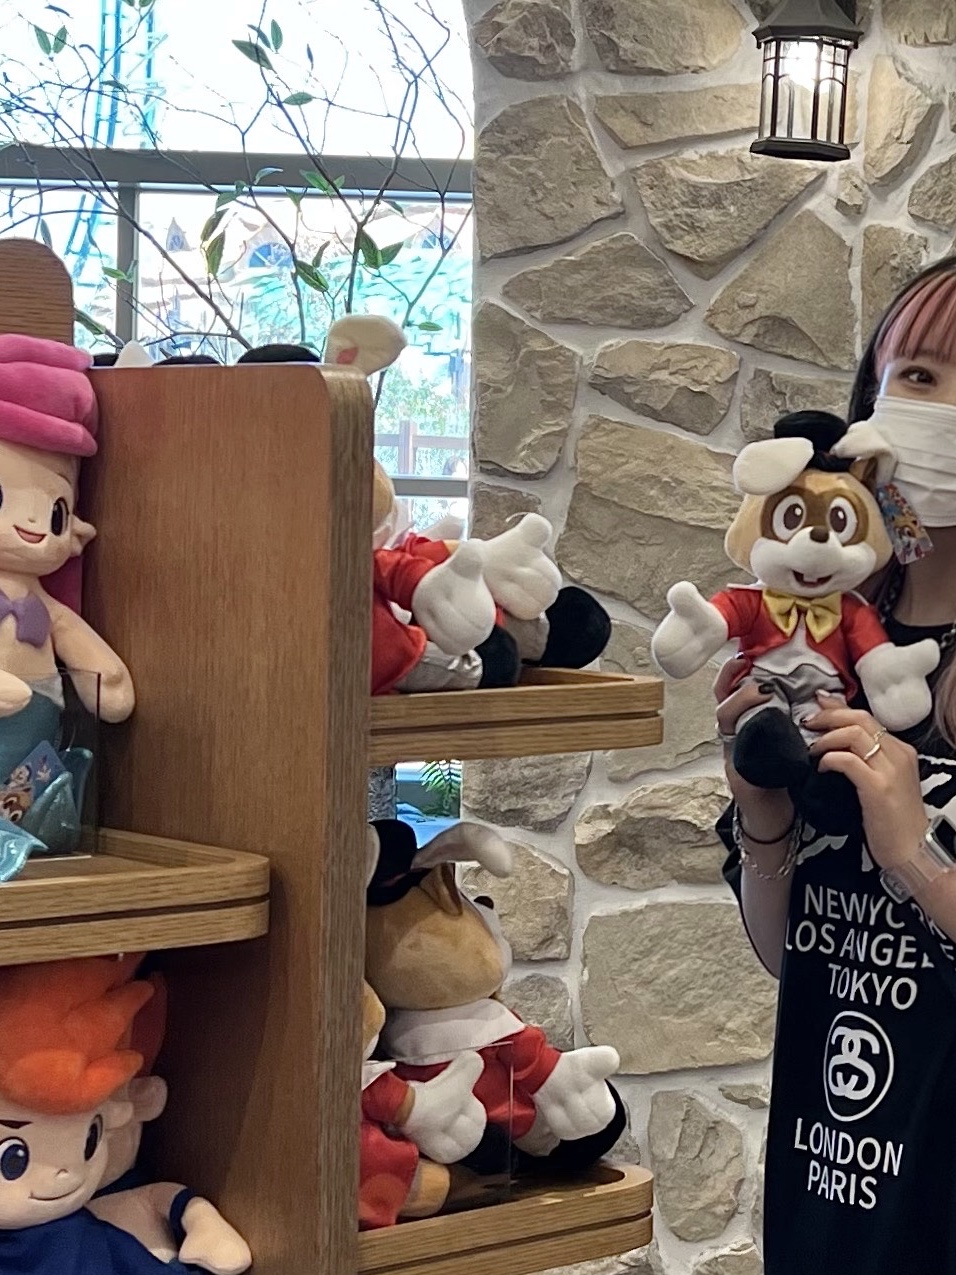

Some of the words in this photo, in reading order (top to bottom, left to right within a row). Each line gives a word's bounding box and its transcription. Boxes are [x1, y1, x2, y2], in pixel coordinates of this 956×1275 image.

[784, 917, 836, 955] LOS
[828, 962, 918, 1010] TOKYO
[794, 1117, 904, 1176] LONDON
[807, 1159, 878, 1210] PARIS
